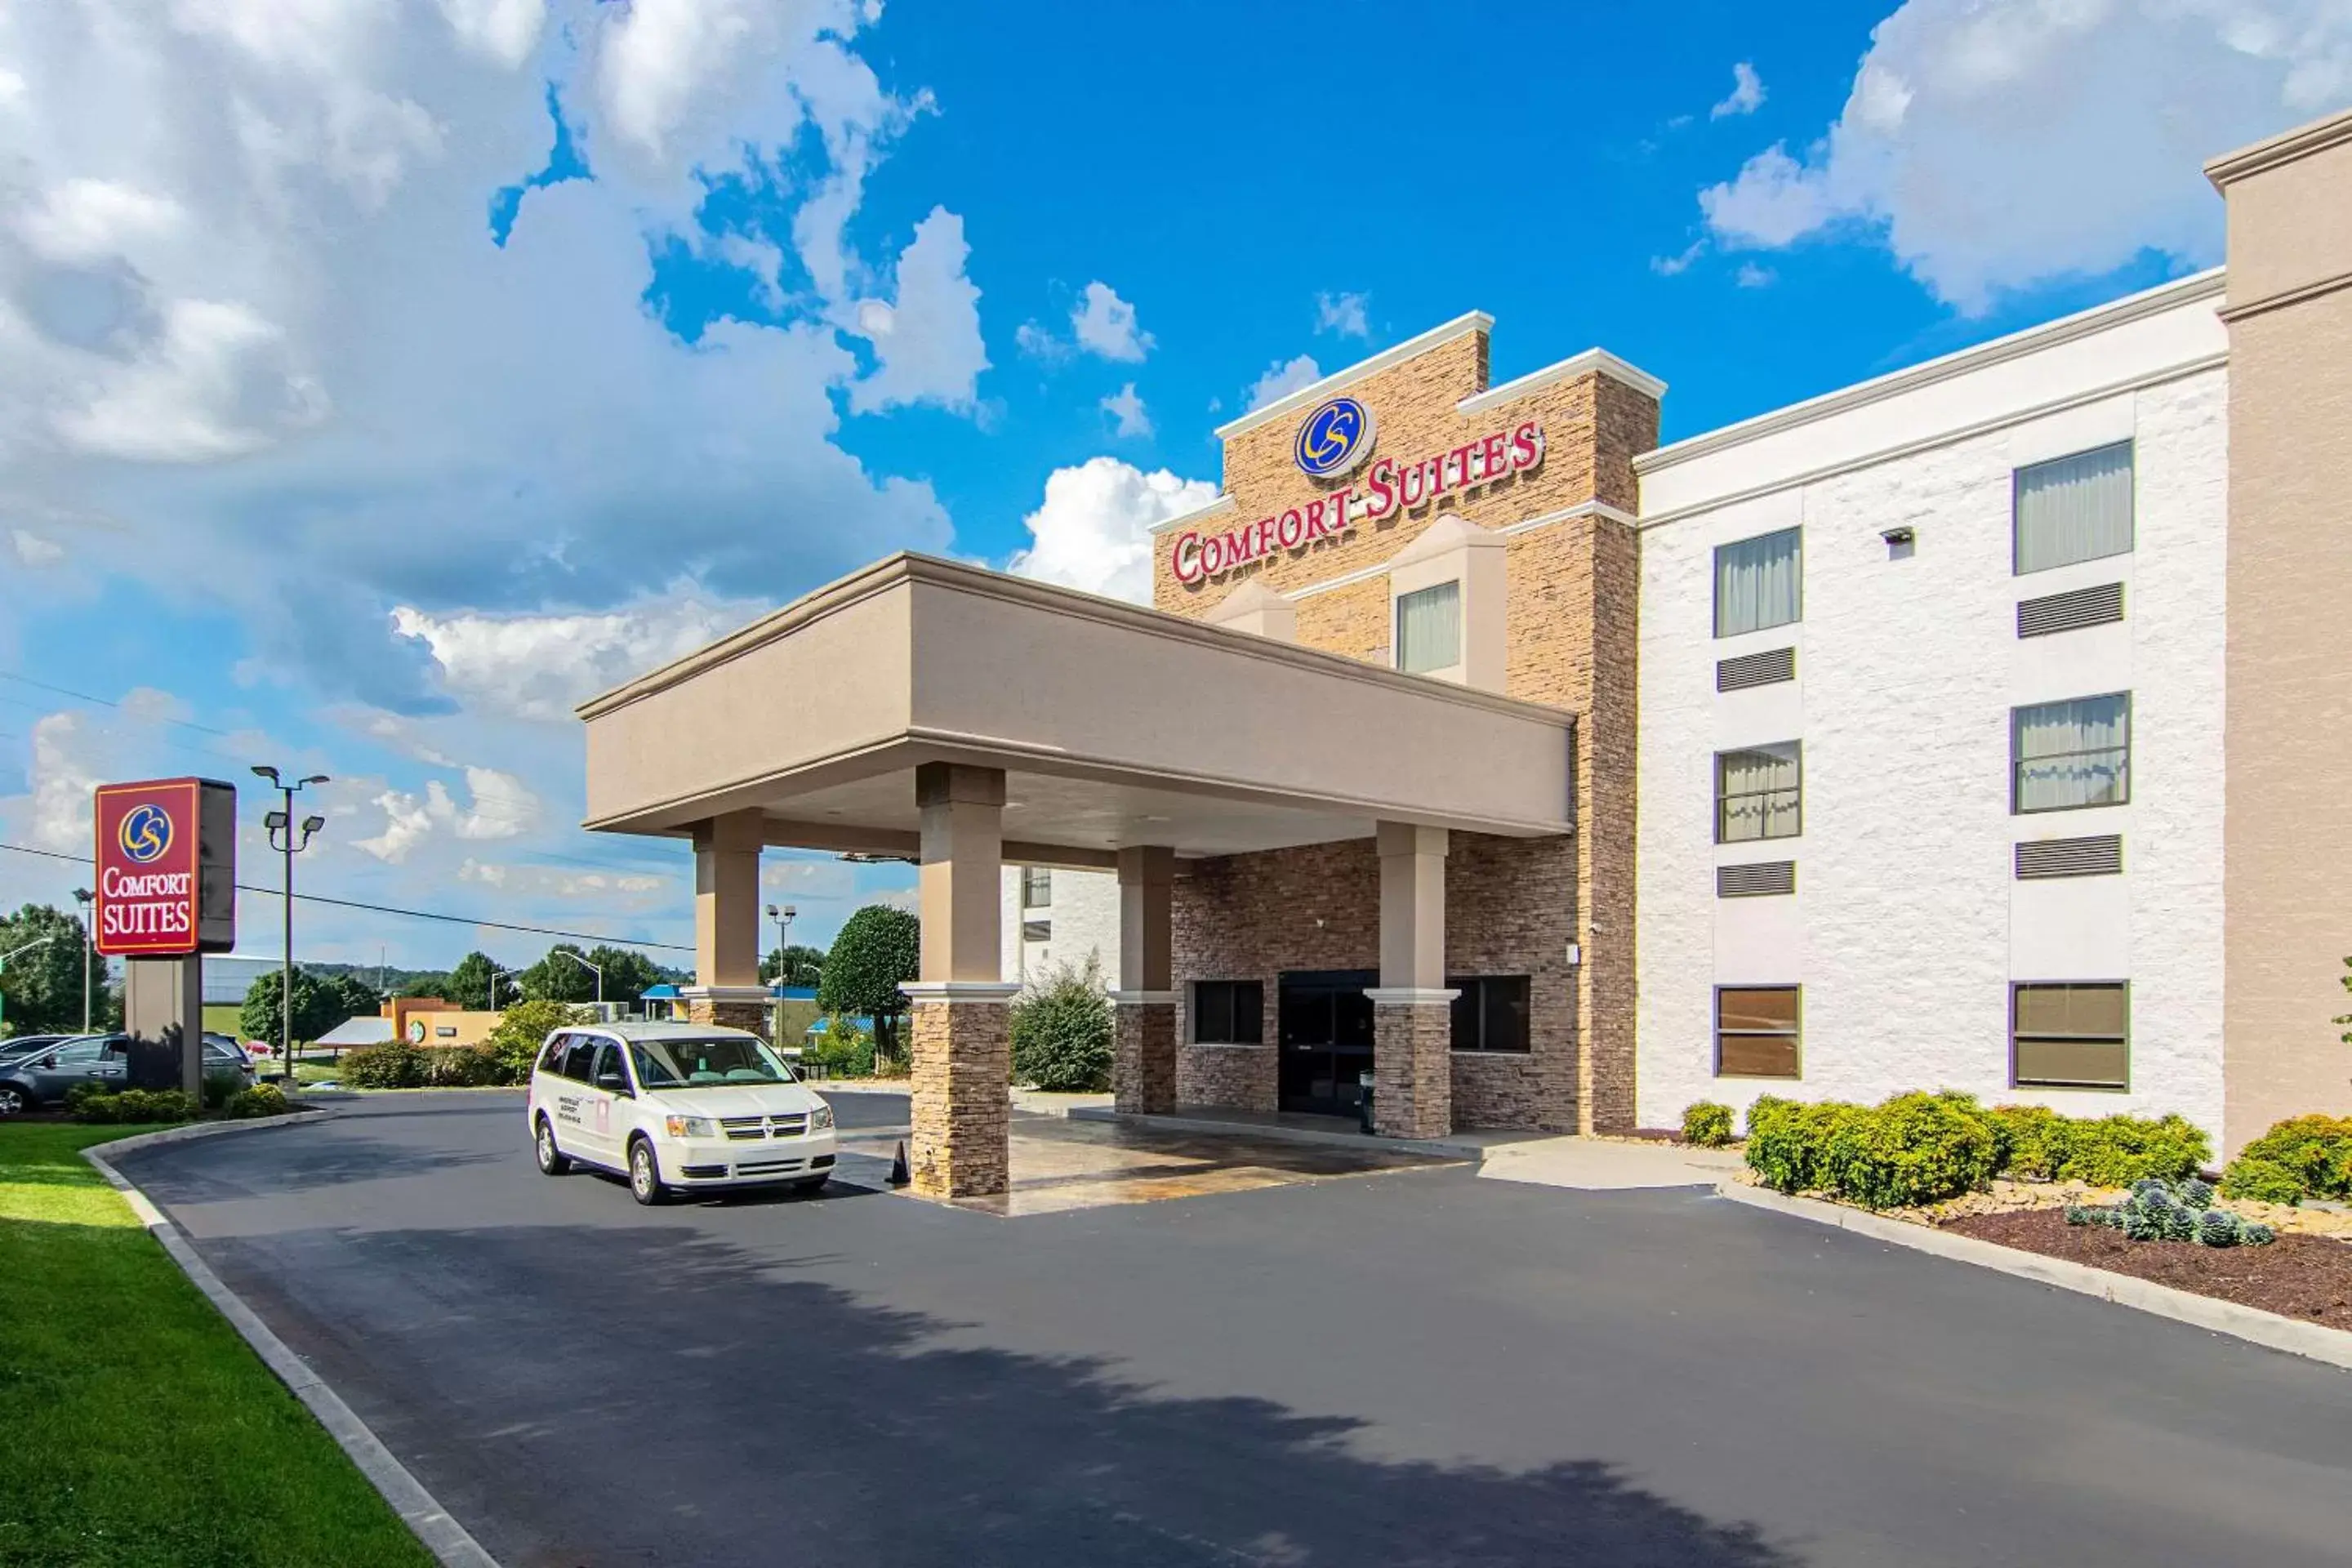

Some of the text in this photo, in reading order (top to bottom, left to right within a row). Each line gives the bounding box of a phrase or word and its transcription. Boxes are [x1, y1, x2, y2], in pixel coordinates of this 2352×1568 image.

[1172, 421, 1539, 582] COMFORT SUITES
[103, 866, 191, 898] COMFORT
[104, 901, 189, 934] SUITES
